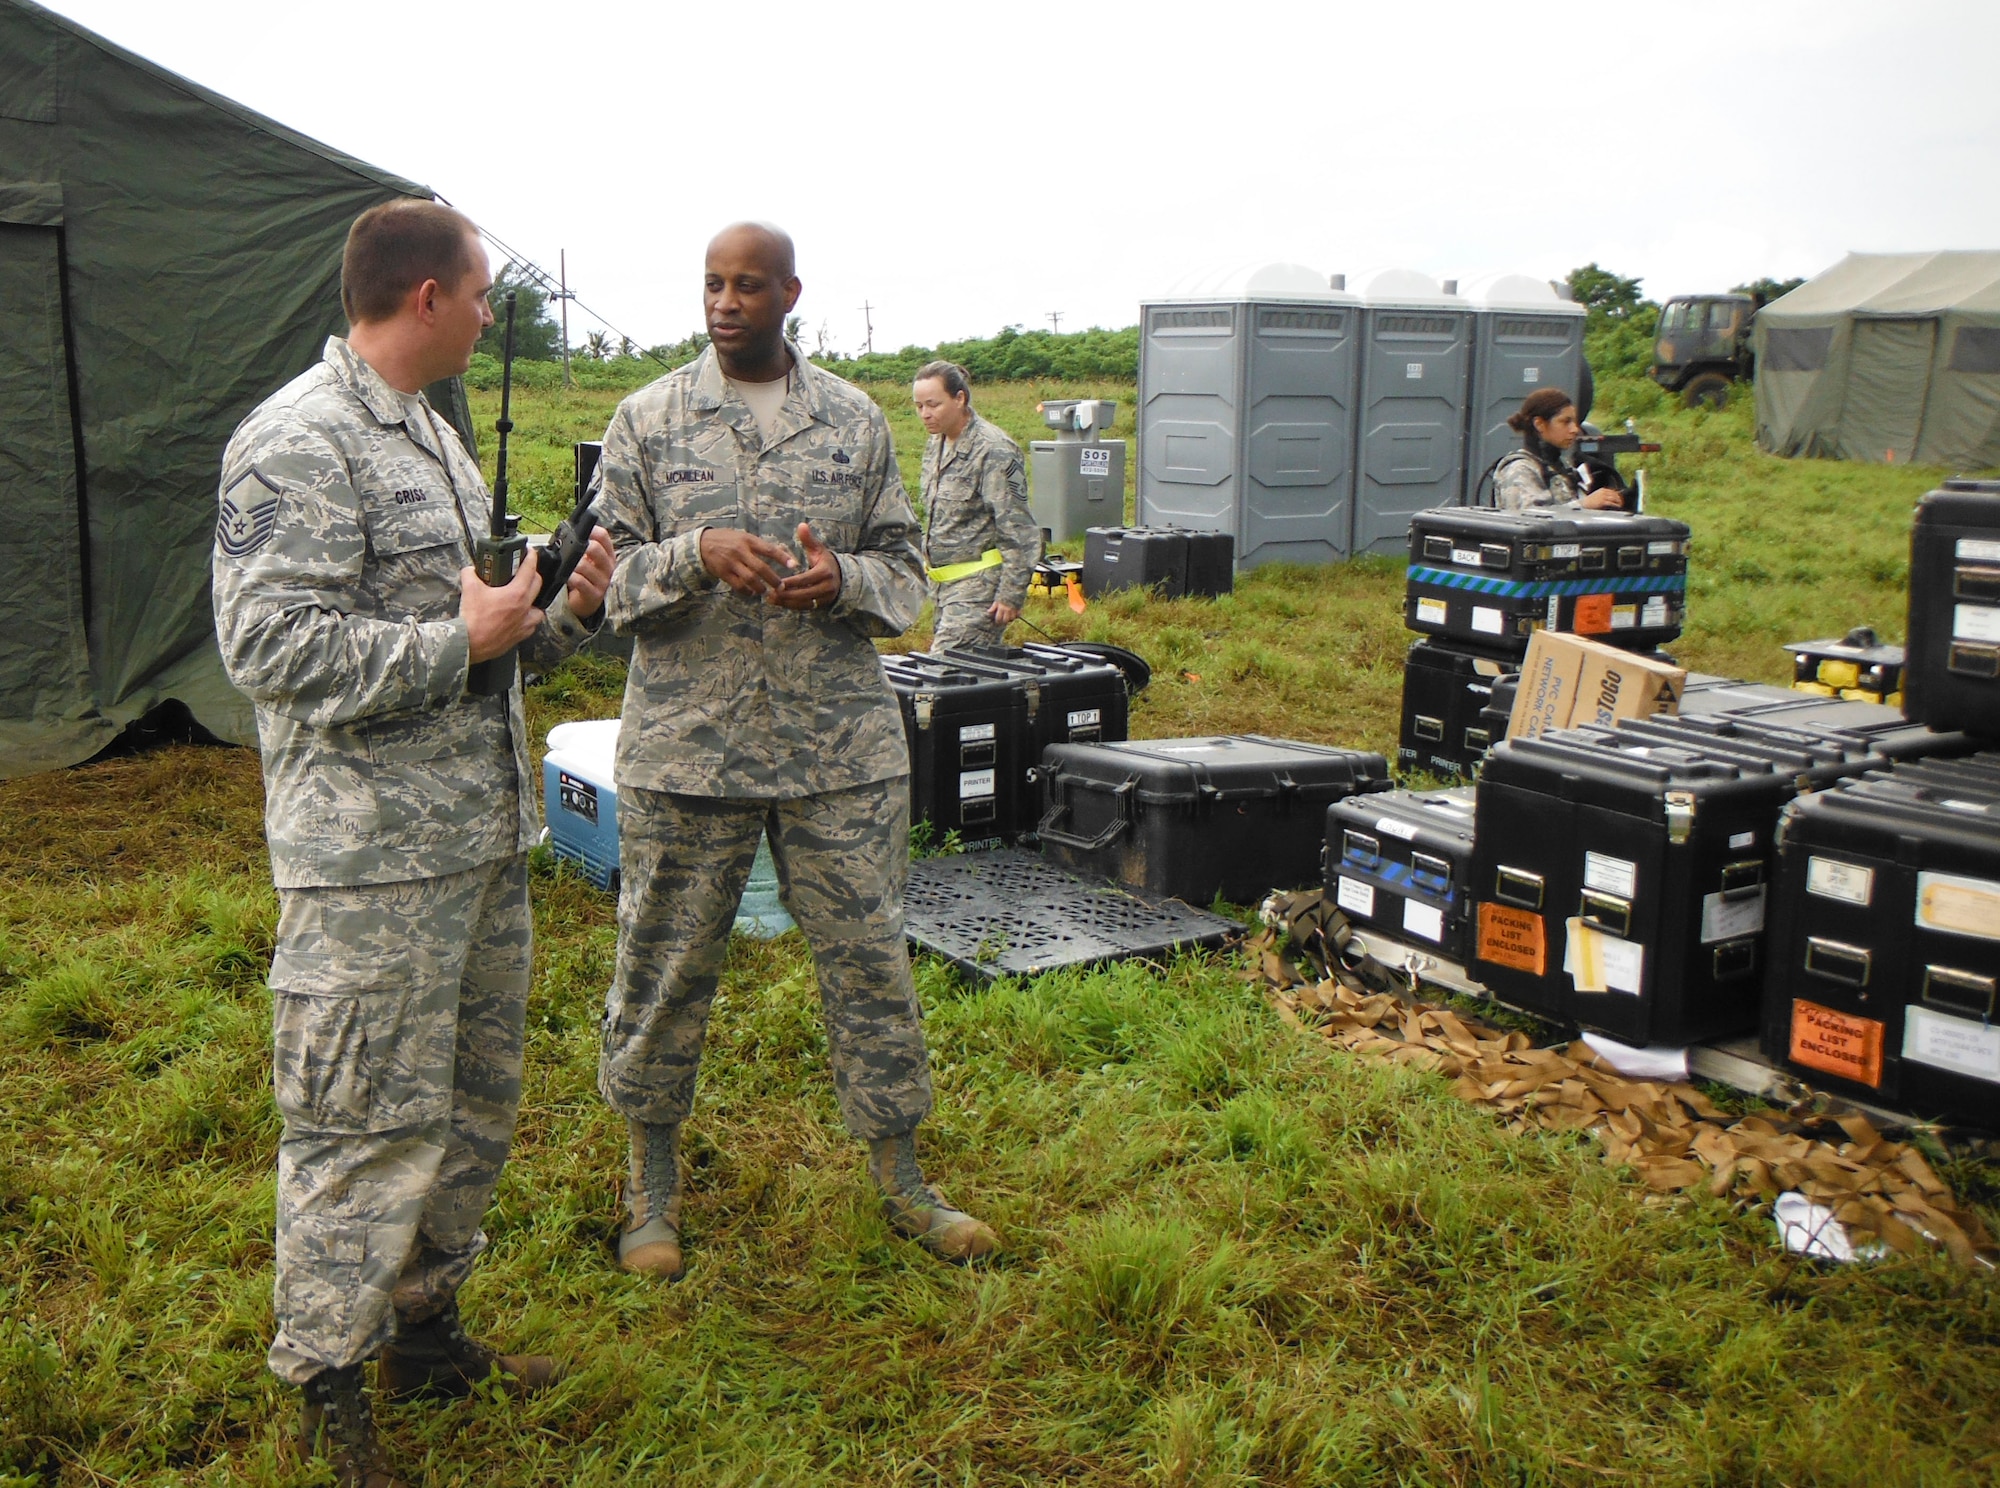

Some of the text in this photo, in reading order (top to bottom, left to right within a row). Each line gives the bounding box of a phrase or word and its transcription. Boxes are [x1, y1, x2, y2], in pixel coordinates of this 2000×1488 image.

[1084, 450, 1107, 460] SOS
[666, 470, 715, 484] MCMILLAN
[812, 470, 862, 487] U.S. AIR FORCE
[395, 488, 427, 504] CRISS
[1457, 552, 1475, 562] BACK
[1533, 657, 1553, 712] NETWORK
[1544, 676, 1562, 730] PVC CAT
[1077, 713, 1092, 723] TOP
[1527, 715, 1540, 738] CAB
[1430, 755, 1461, 771] PRINTER
[963, 777, 991, 787] PRINTER
[964, 837, 1001, 852] PRINTER
[1490, 914, 1532, 932] PACKING
[1501, 929, 1521, 941] LIST
[1486, 938, 1536, 956] ENCLOSED
[1807, 1015, 1863, 1038] PACKING
[1819, 1032, 1848, 1047] LIST
[1800, 1040, 1868, 1065] ENCLOSED
